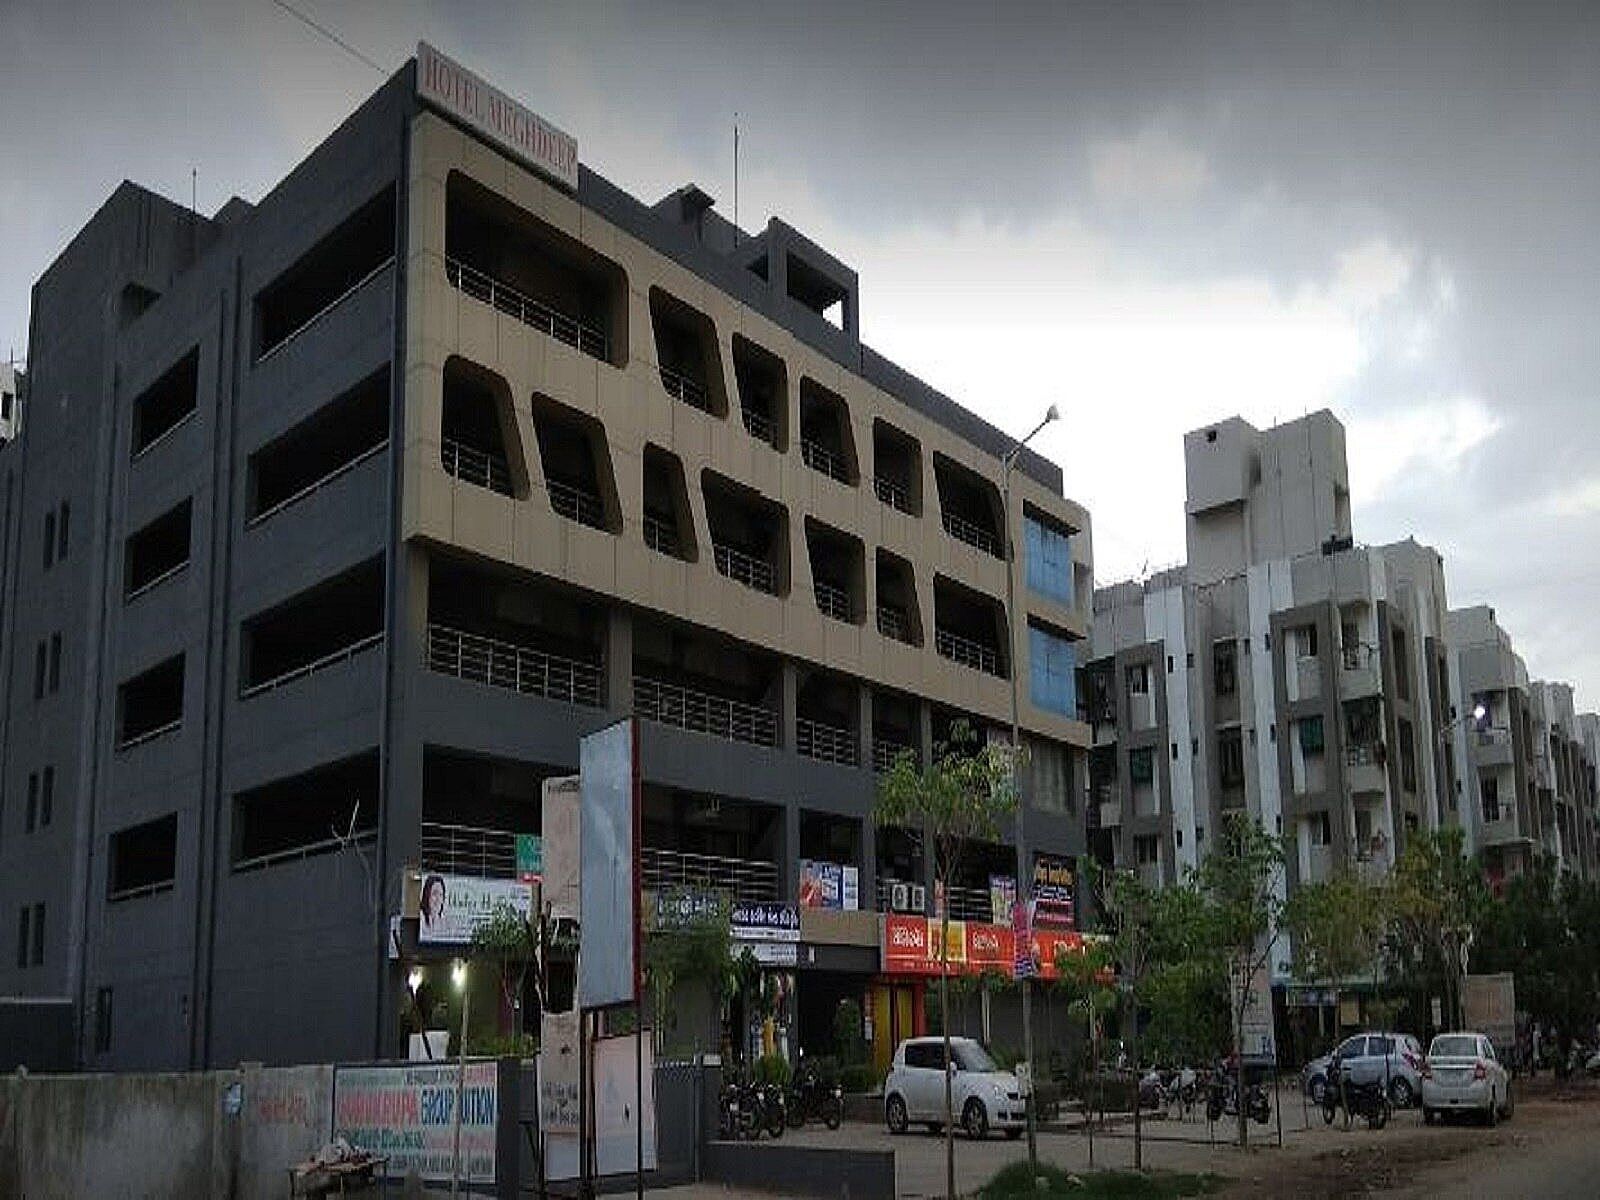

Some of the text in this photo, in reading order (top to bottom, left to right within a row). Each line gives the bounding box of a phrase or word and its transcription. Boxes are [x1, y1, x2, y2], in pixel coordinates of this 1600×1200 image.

[424, 53, 479, 119] HOTEL
[421, 1087, 455, 1125] GROUP
[458, 1086, 496, 1125] UITION
